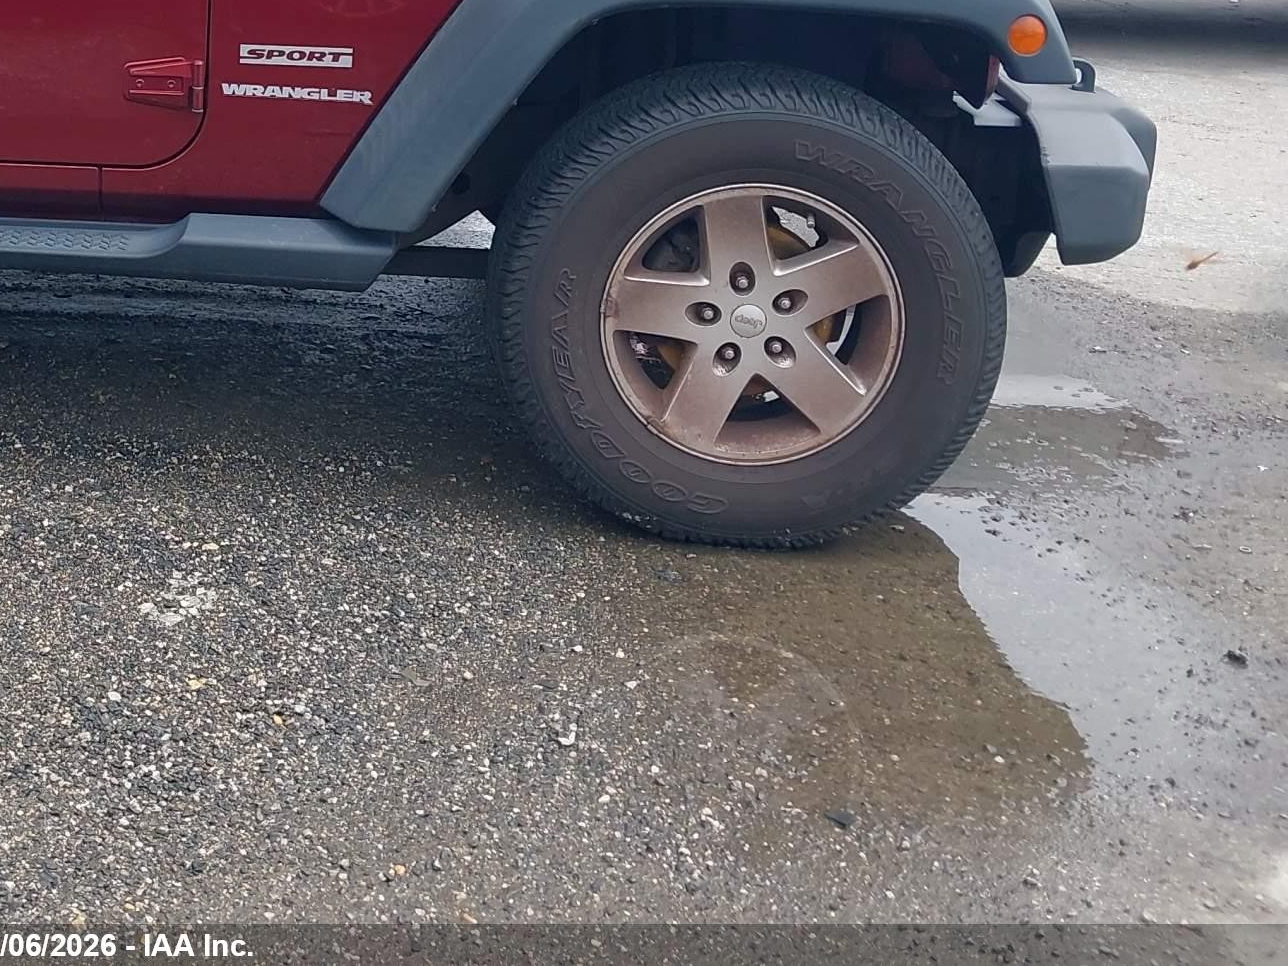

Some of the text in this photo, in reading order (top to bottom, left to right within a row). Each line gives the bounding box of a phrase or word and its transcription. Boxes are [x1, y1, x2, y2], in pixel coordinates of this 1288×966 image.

[222, 82, 374, 106] WRANGLER
[244, 47, 349, 64] SPORT
[793, 139, 965, 387] WRANGLER
[549, 267, 729, 516] GOODYEAR
